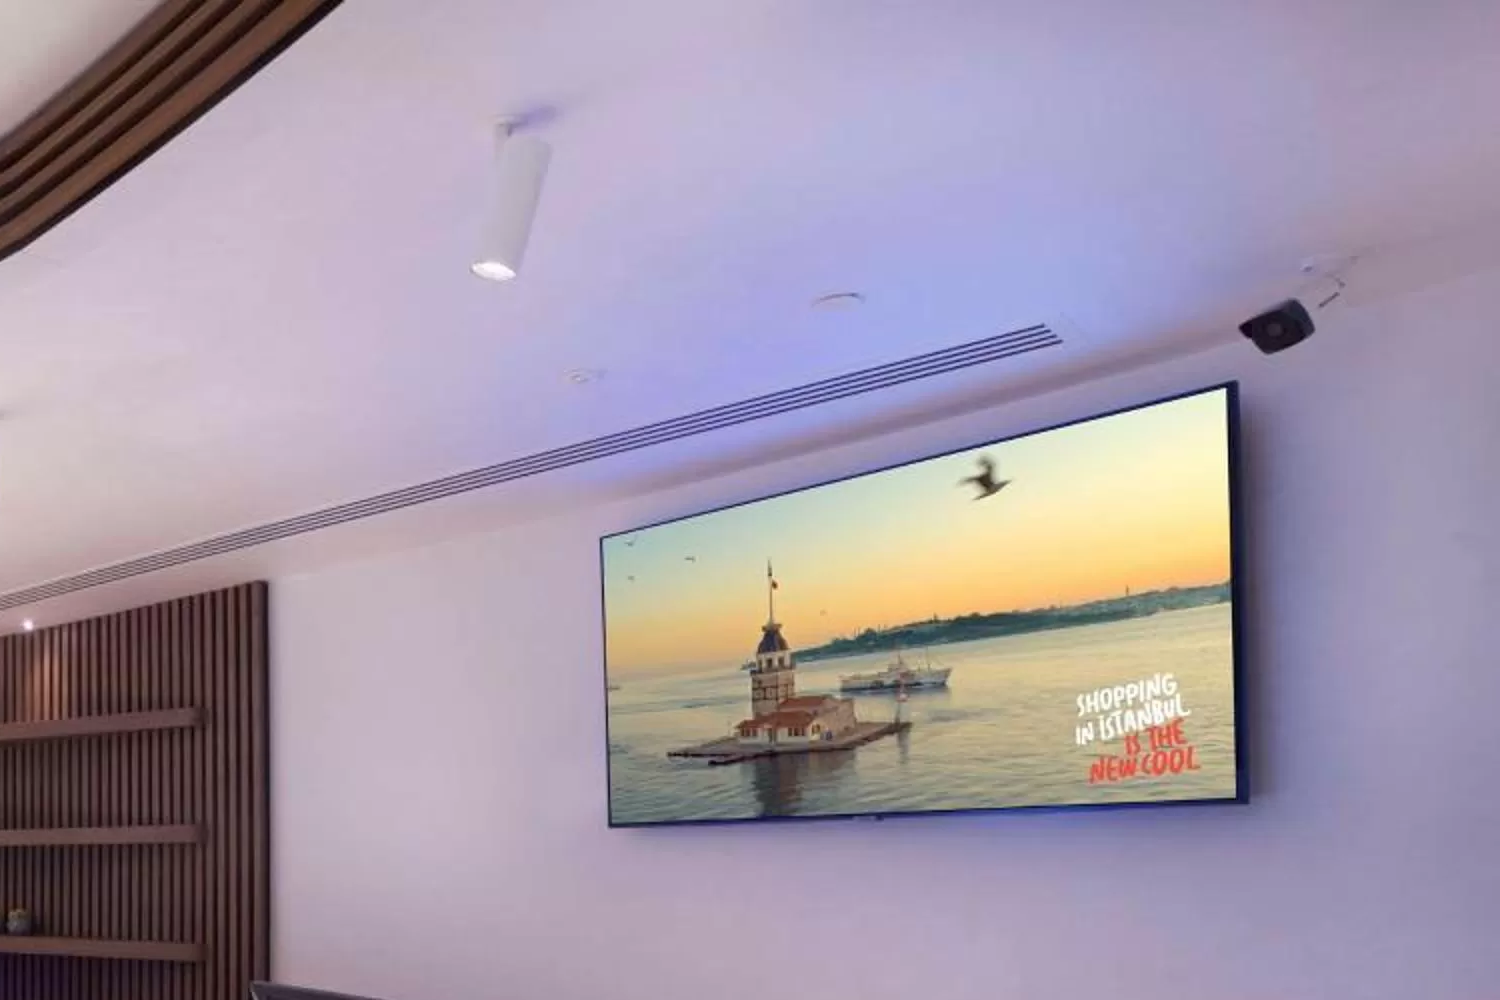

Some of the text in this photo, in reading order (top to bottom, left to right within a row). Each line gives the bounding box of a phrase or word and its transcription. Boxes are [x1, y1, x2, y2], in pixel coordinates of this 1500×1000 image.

[1076, 673, 1177, 716] SHOPPING
[1075, 722, 1094, 746] IN
[1124, 717, 1188, 757] IS THE
[1088, 747, 1201, 784] NEW COOL
